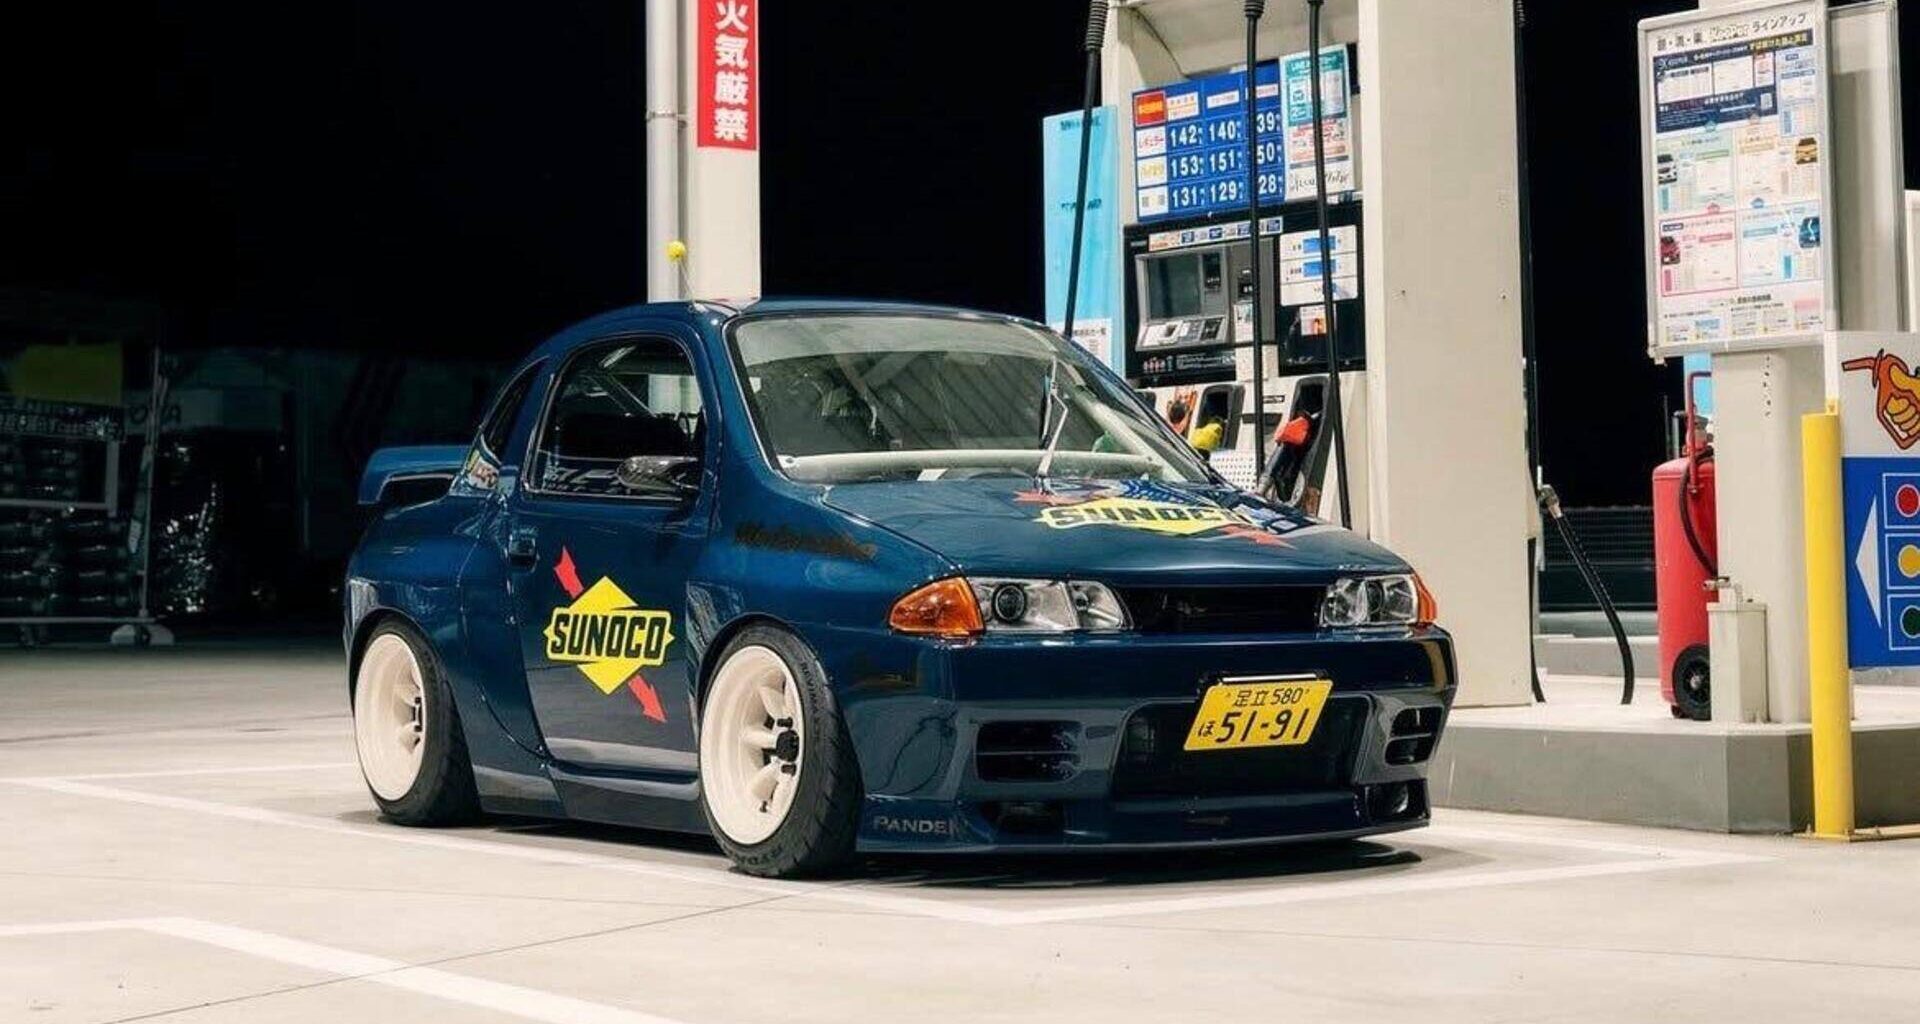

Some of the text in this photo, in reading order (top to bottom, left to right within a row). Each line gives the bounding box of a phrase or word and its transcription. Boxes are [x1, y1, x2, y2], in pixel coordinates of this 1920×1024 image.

[1752, 12, 1807, 33] ラインアップ
[714, 0, 749, 142] 火気厳禁
[1170, 125, 1198, 147] 142
[1209, 120, 1237, 141] 140
[1256, 112, 1275, 133] 39
[1171, 155, 1199, 178] 153
[1210, 149, 1235, 171] 151
[1256, 142, 1275, 164] 50
[1172, 186, 1197, 208] 131
[1210, 180, 1237, 203] 129
[1258, 174, 1276, 194] 28
[551, 613, 668, 659] SUNOCO
[1233, 687, 1304, 708] 足立 580
[1197, 708, 1310, 743] ほ 51-91
